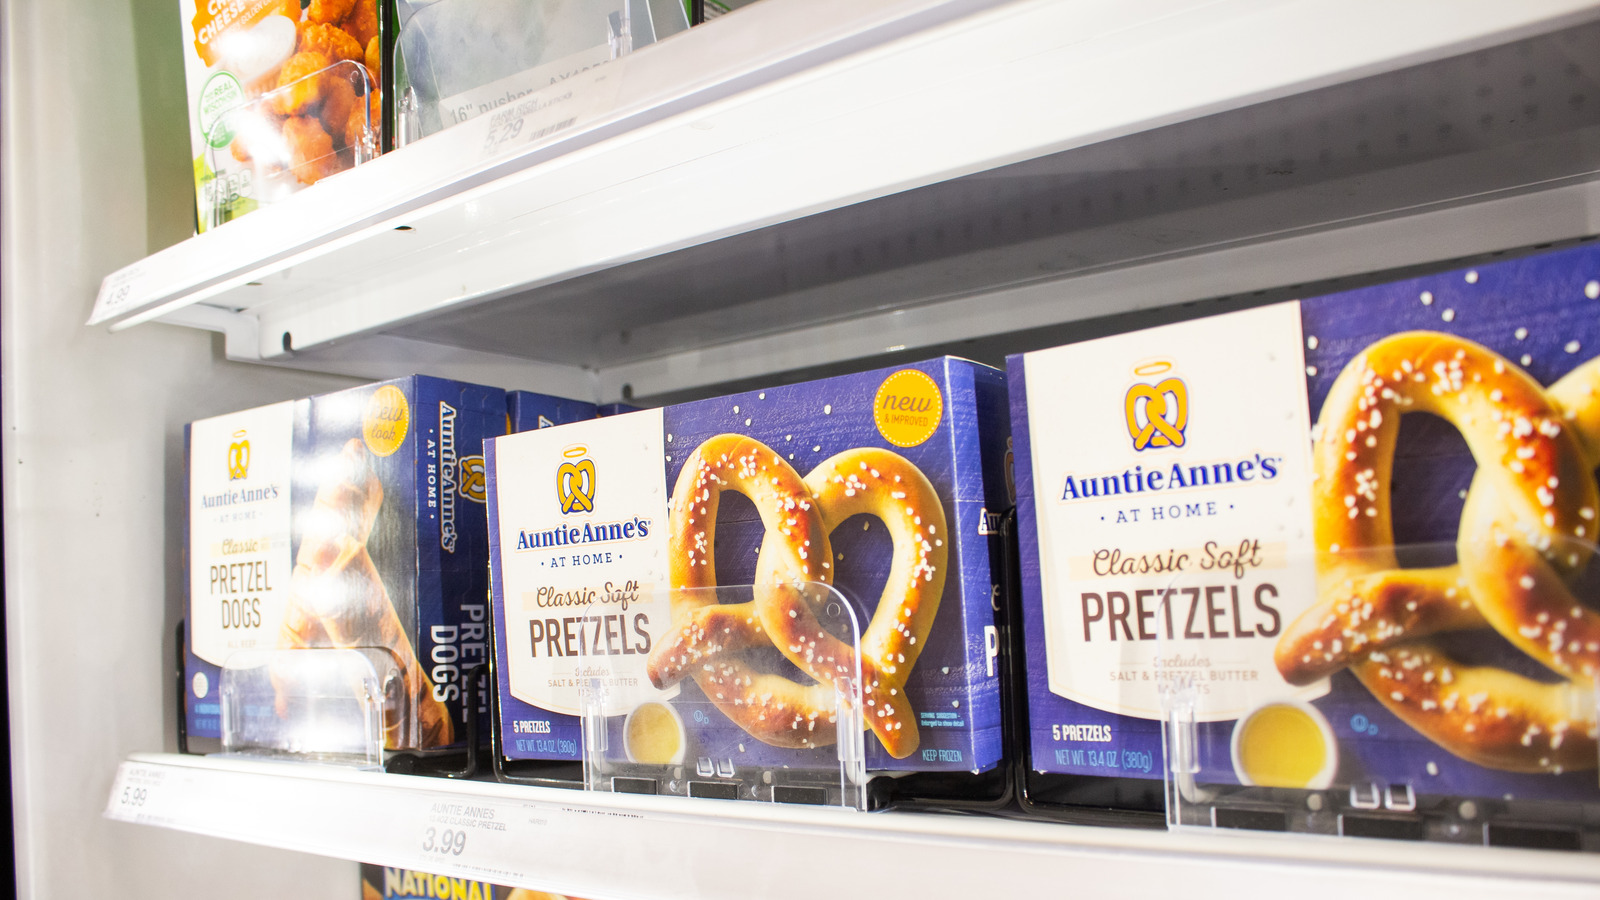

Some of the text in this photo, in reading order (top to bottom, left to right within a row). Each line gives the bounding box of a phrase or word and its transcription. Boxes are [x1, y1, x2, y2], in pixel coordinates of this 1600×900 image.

[484, 118, 524, 149] 5.29
[883, 394, 933, 413] new
[370, 405, 404, 422] new
[885, 414, 929, 427] & IMPROVED
[371, 424, 396, 442] look
[427, 439, 437, 508] AT HOME
[1116, 502, 1217, 523] AT HOME
[222, 538, 258, 555] Classic
[551, 552, 612, 568] AT HOME
[1092, 538, 1262, 579] Classic Soft
[210, 560, 272, 595] PRETZEL
[536, 580, 640, 611] Classic Soft
[221, 598, 261, 629] DOGS
[1081, 583, 1281, 642] PRETZELS
[529, 613, 651, 658] PRETZELS
[431, 625, 459, 703] DOGS
[548, 679, 565, 688] SALT
[1110, 671, 1137, 681] SALT
[1142, 672, 1149, 681] &
[1210, 670, 1259, 681] BUTTER
[513, 720, 551, 734] 5 PRETZELS
[1052, 724, 1112, 742] 5 PRETZELS
[516, 740, 525, 752] NET
[526, 740, 536, 752] WT.
[536, 740, 548, 753] 13.4
[557, 738, 577, 756] (380g)
[922, 749, 963, 762] KEEP FROZEN
[1055, 749, 1069, 765] NET
[1071, 750, 1087, 766] WT.
[1088, 750, 1105, 767] 13.4
[1121, 748, 1152, 773] (380g)
[121, 786, 147, 807] 5.99
[431, 802, 495, 819] AUNTIE ANNES
[449, 816, 477, 828] CLASSIC
[477, 819, 507, 831] PRETZEL
[422, 826, 466, 856] 3.99
